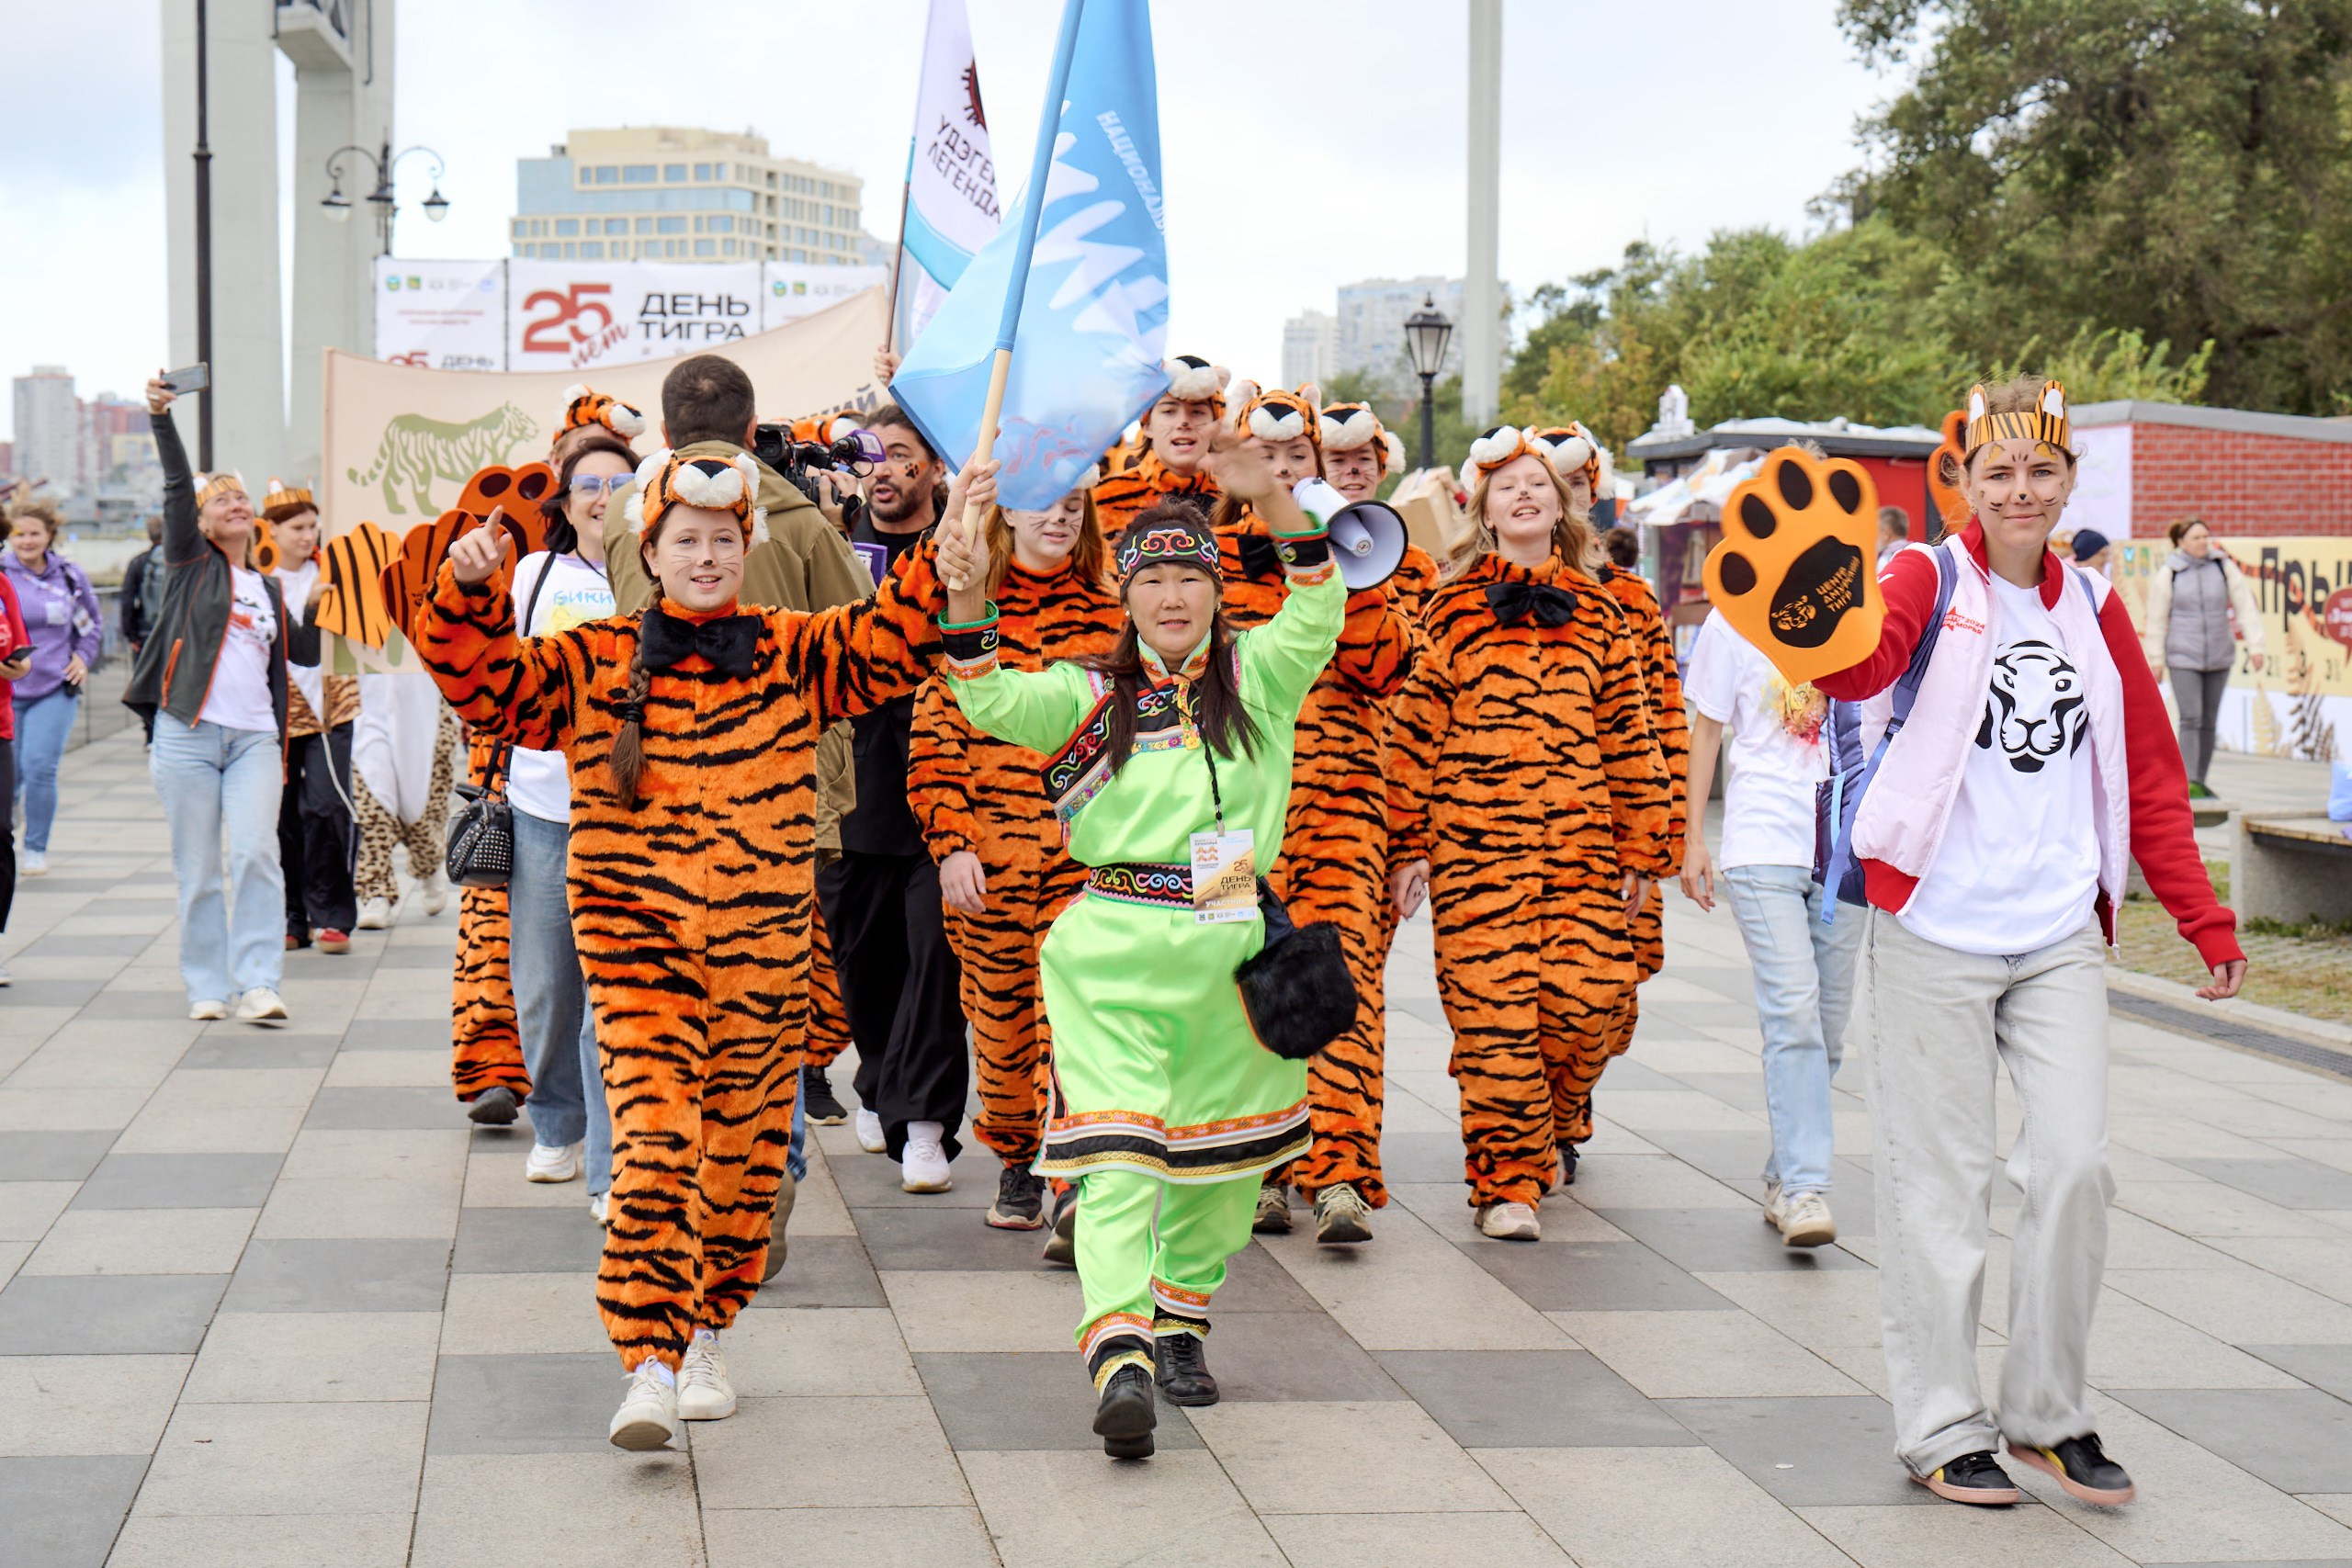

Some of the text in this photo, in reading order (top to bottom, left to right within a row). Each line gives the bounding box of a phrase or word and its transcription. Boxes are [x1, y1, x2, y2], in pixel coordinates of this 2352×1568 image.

[639, 293, 750, 317] ДЕНЬ
[522, 283, 613, 353] 25
[637, 321, 746, 340] ТИГРА
[1815, 566, 1847, 596] ЦЕНТР
[2261, 547, 2352, 633] Пры
[1826, 589, 1853, 613] ТИГР
[1220, 875, 1251, 885] ДЕНЬ
[1221, 883, 1251, 891] ТИГРА
